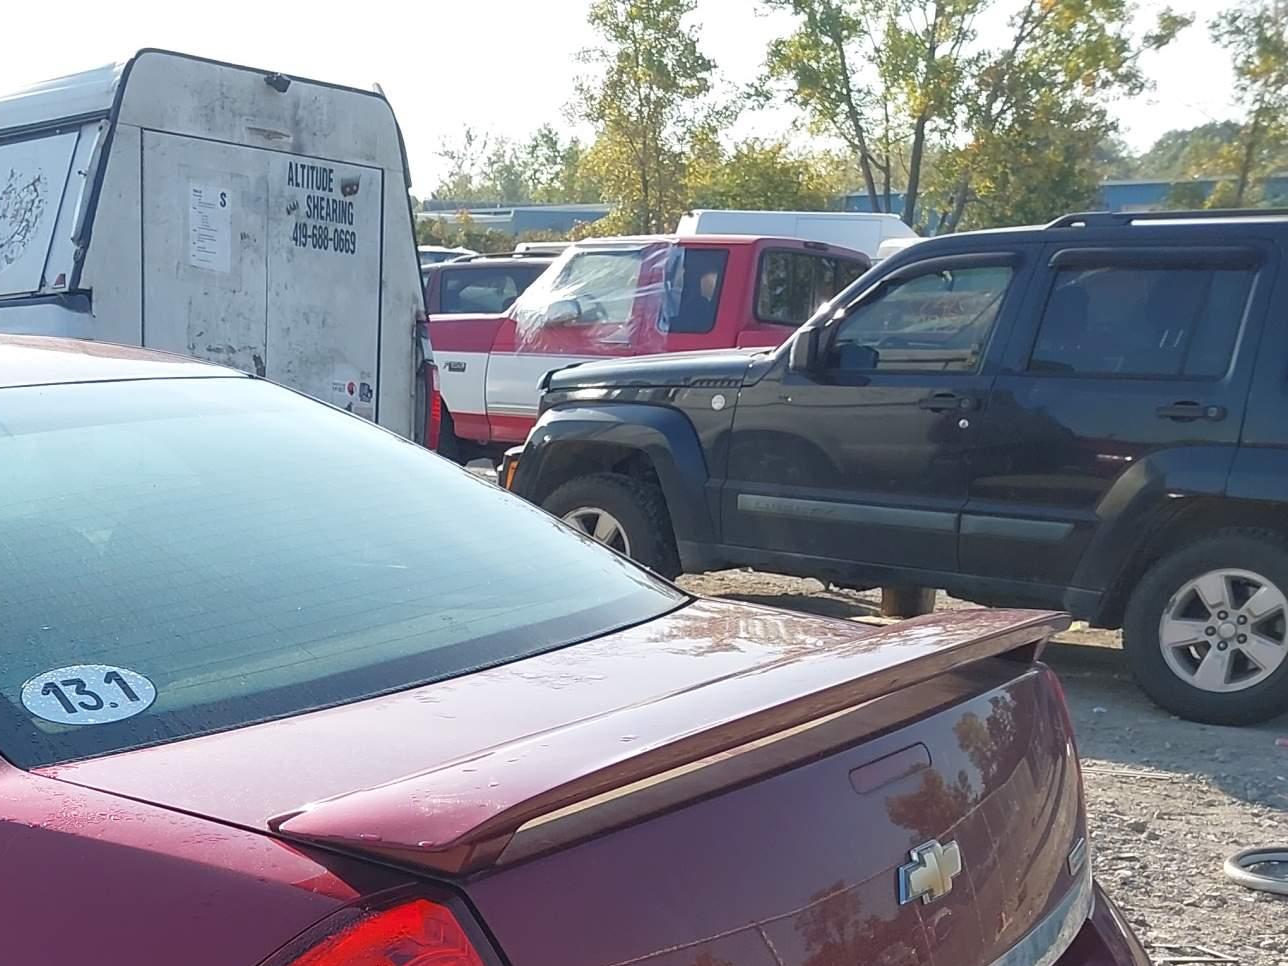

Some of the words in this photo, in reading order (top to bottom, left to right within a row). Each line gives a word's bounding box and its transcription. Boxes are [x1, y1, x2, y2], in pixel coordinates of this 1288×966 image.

[287, 161, 334, 192] ALTITUDE
[305, 194, 354, 226] SHEARING
[292, 222, 356, 255] 419-688-0669
[41, 670, 141, 714] 13.1
